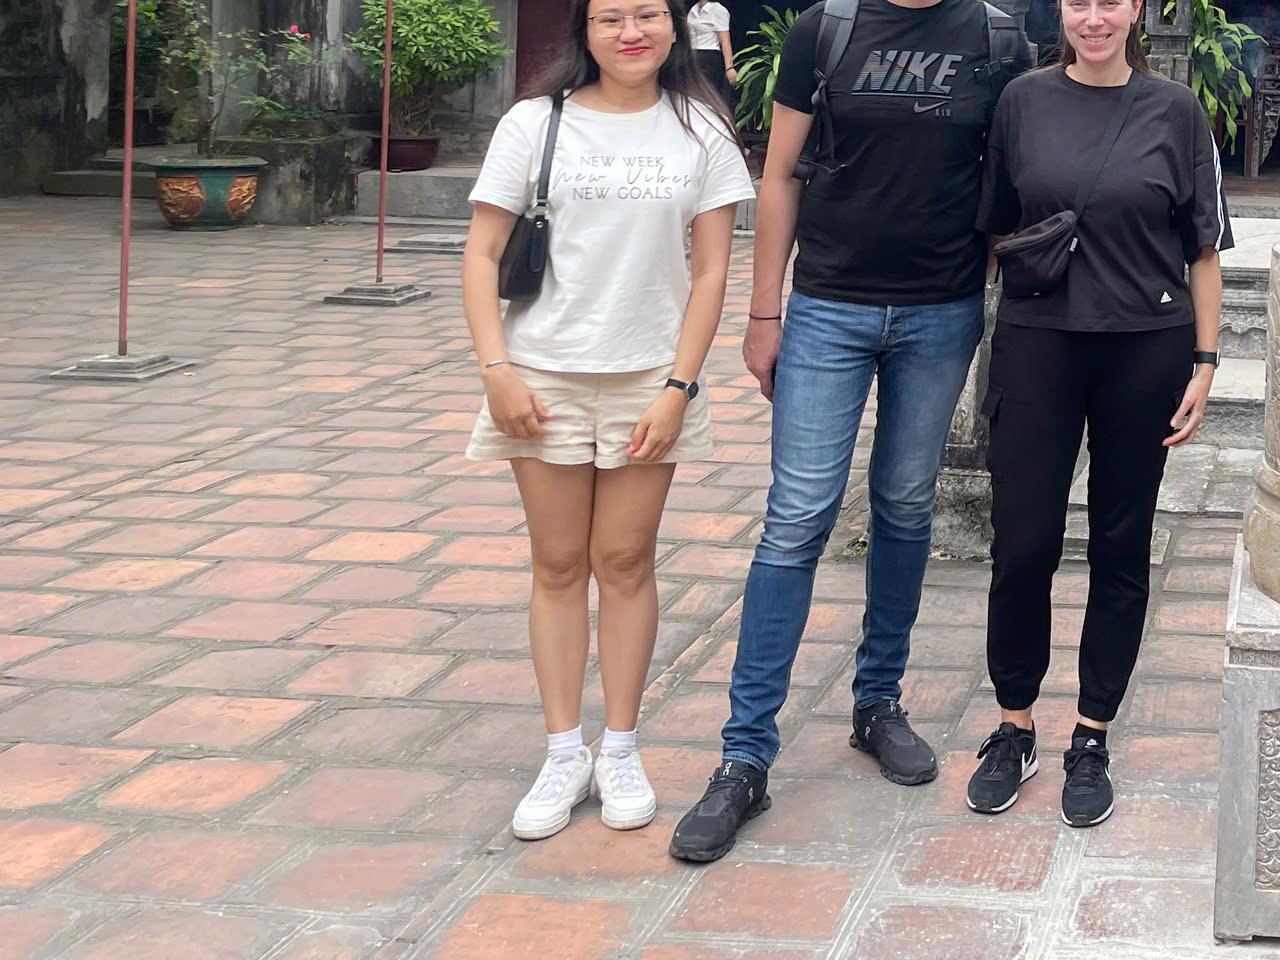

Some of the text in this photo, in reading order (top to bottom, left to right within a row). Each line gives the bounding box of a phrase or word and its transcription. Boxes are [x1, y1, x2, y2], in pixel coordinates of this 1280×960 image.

[852, 50, 963, 95] NIKE
[580, 156, 665, 168] NEW WEEK
[572, 187, 673, 200] NEW GOALS
